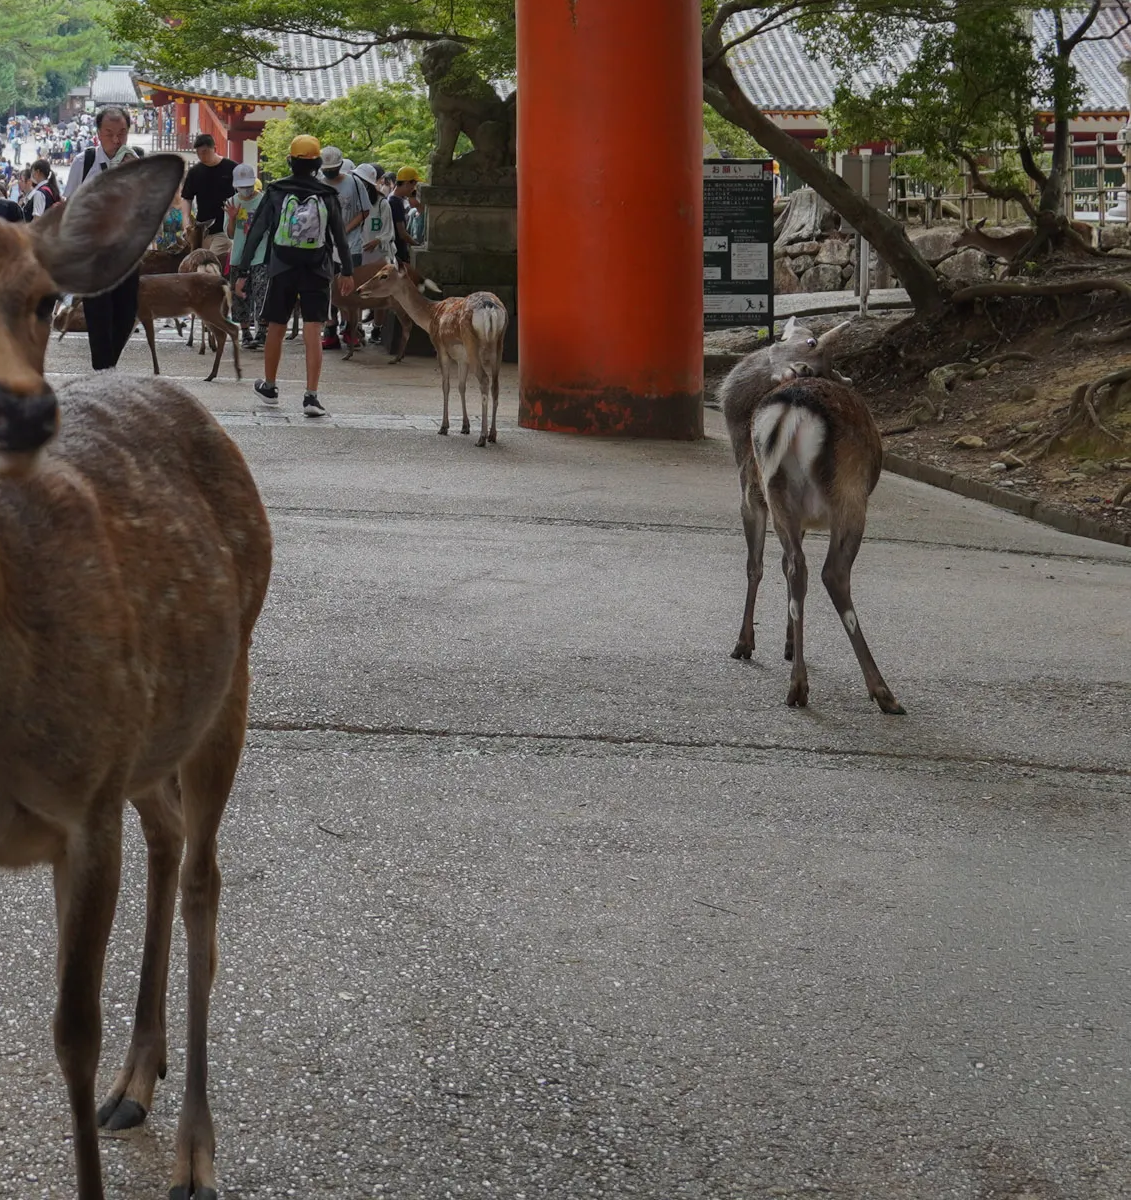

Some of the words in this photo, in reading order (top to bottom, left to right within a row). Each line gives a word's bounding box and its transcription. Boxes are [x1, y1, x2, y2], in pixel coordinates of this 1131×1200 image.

[712, 165, 742, 174] お願い
[371, 218, 382, 231] B
